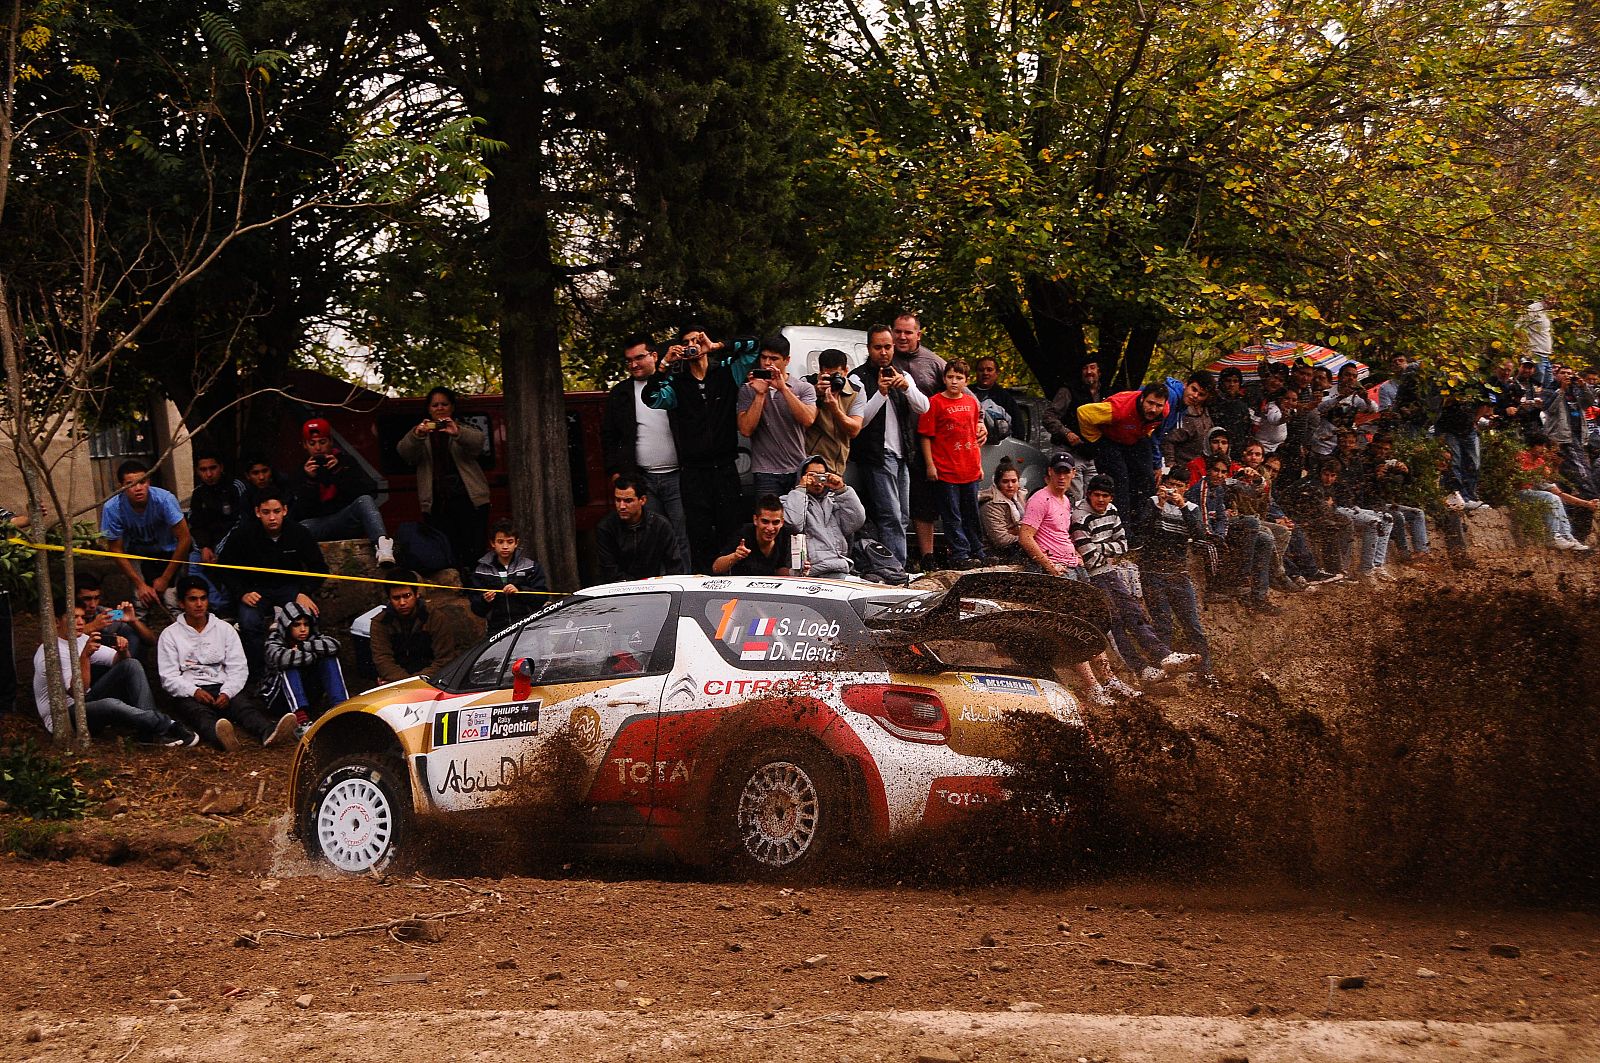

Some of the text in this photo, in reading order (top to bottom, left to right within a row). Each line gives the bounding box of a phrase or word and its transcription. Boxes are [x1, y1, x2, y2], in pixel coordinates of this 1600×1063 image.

[714, 598, 738, 640] 1
[778, 618, 840, 637] S. Loeb
[769, 640, 837, 662] D. Elena
[985, 679, 1034, 691] MICHELIN
[492, 706, 520, 716] PHILIPS
[497, 716, 512, 725] Rally
[441, 712, 450, 745] 1
[491, 720, 538, 737] Argentina
[436, 757, 499, 795] Abu
[612, 757, 696, 785] TOTA
